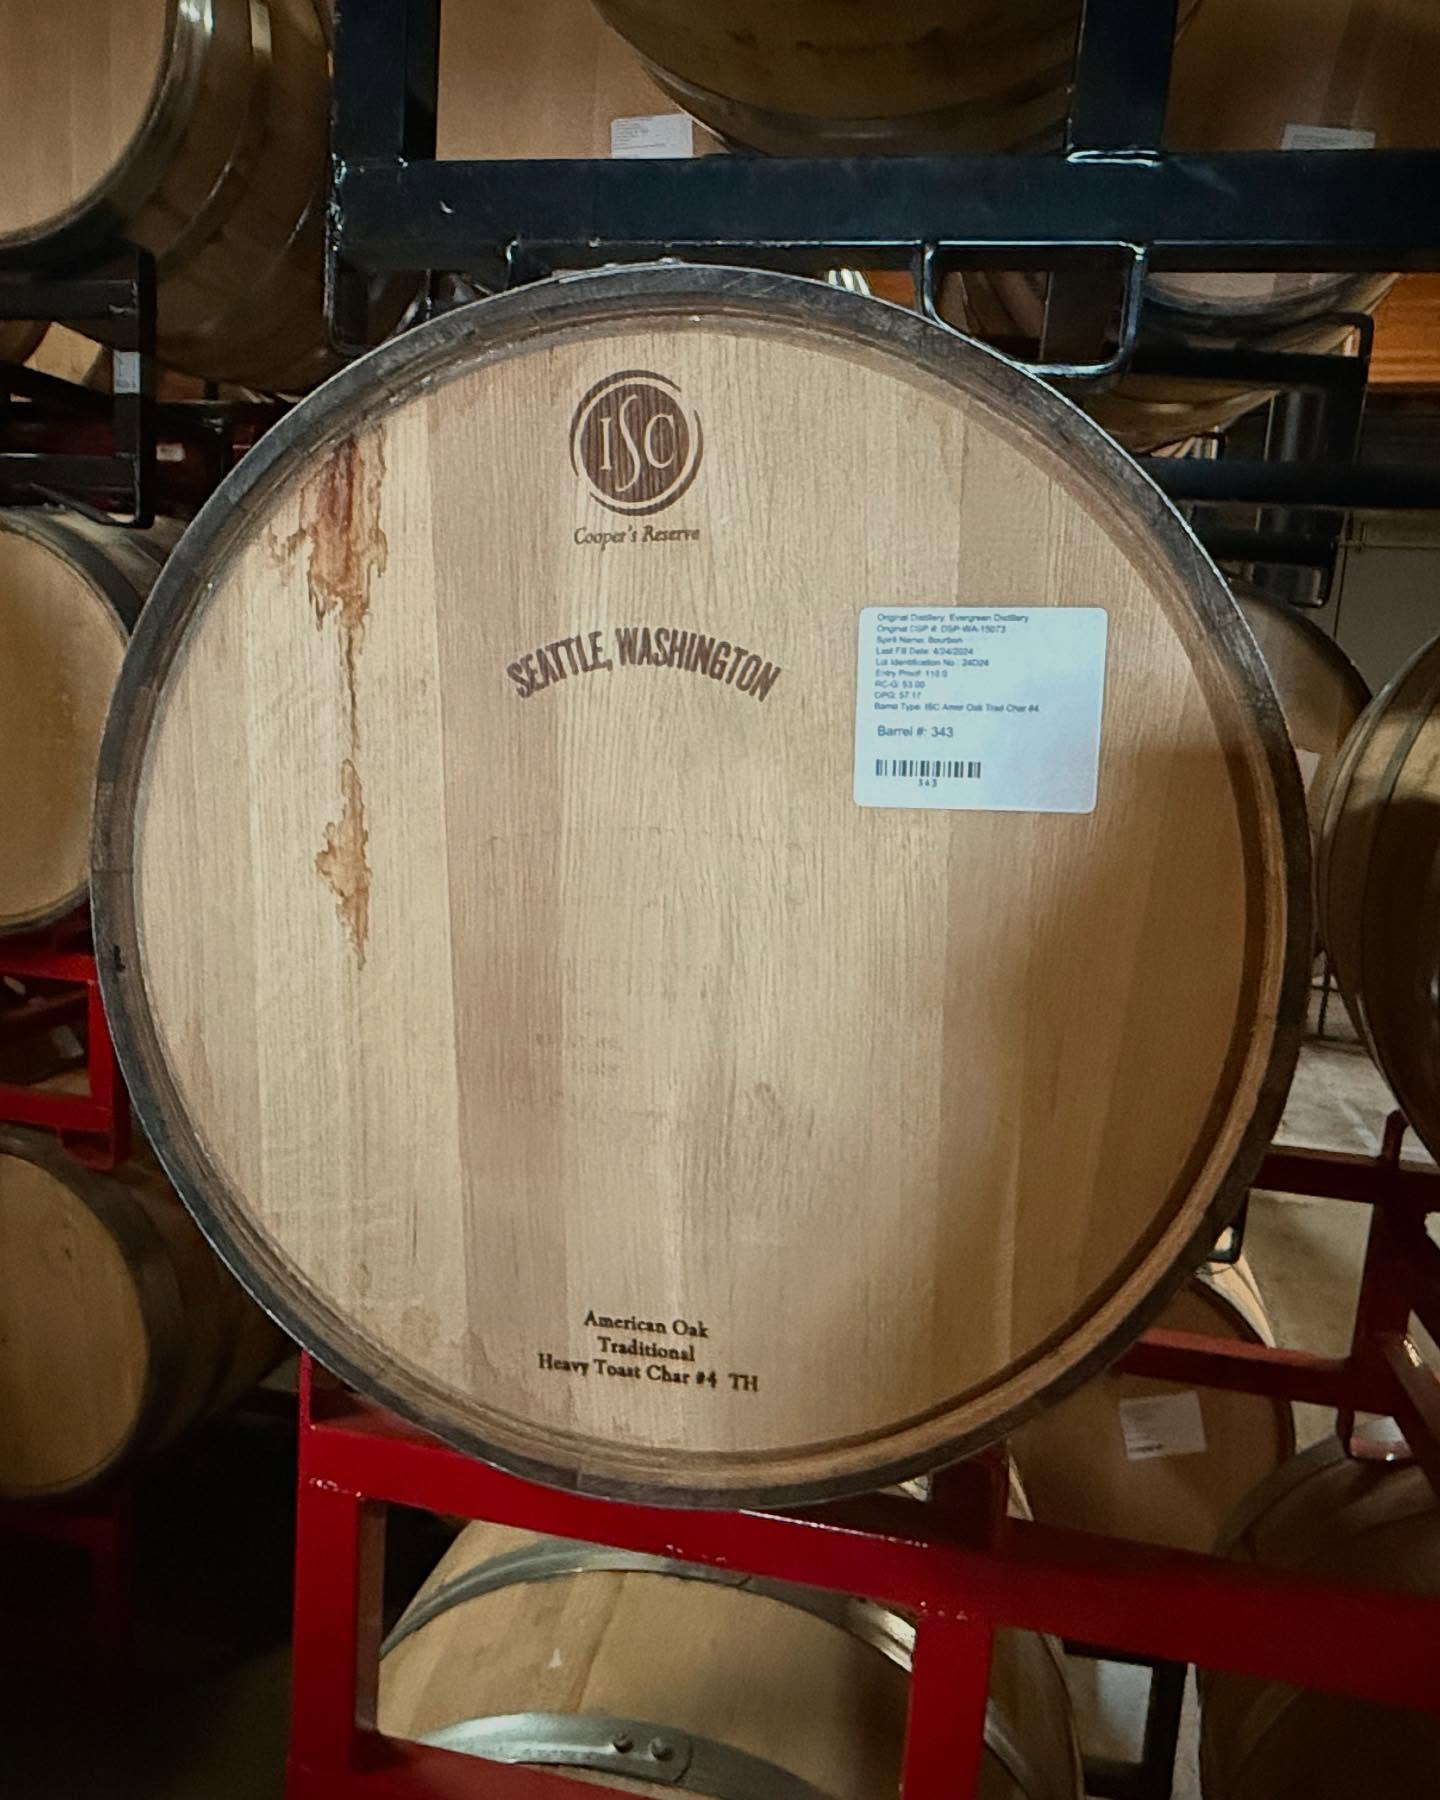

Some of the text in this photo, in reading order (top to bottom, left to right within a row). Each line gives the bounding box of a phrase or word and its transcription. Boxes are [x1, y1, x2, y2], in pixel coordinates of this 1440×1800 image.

[600, 394, 674, 492] ISC
[574, 525, 700, 550] Cooper's Reserve
[877, 614, 908, 623] Original
[949, 614, 992, 623] Evergreen
[993, 614, 1029, 624] Distillery
[876, 625, 908, 634] Original
[910, 625, 928, 633] DSP
[876, 635, 897, 644] Spirit
[927, 636, 963, 644] Bourbon
[876, 647, 893, 655] Last
[895, 647, 908, 655] Fill
[506, 627, 782, 702] SEATTLE, WASHINGTON
[876, 658, 888, 666] Lot
[875, 669, 897, 678] Entry
[874, 702, 898, 710] Barrel
[966, 704, 983, 712] Oak
[1006, 704, 1027, 713] Char
[877, 725, 913, 737] Barrel
[931, 726, 954, 738] 343
[583, 1310, 709, 1338] American Oak
[597, 1336, 695, 1362] Traditional
[537, 1353, 758, 1392] Heavy Toast Char #4 TH
